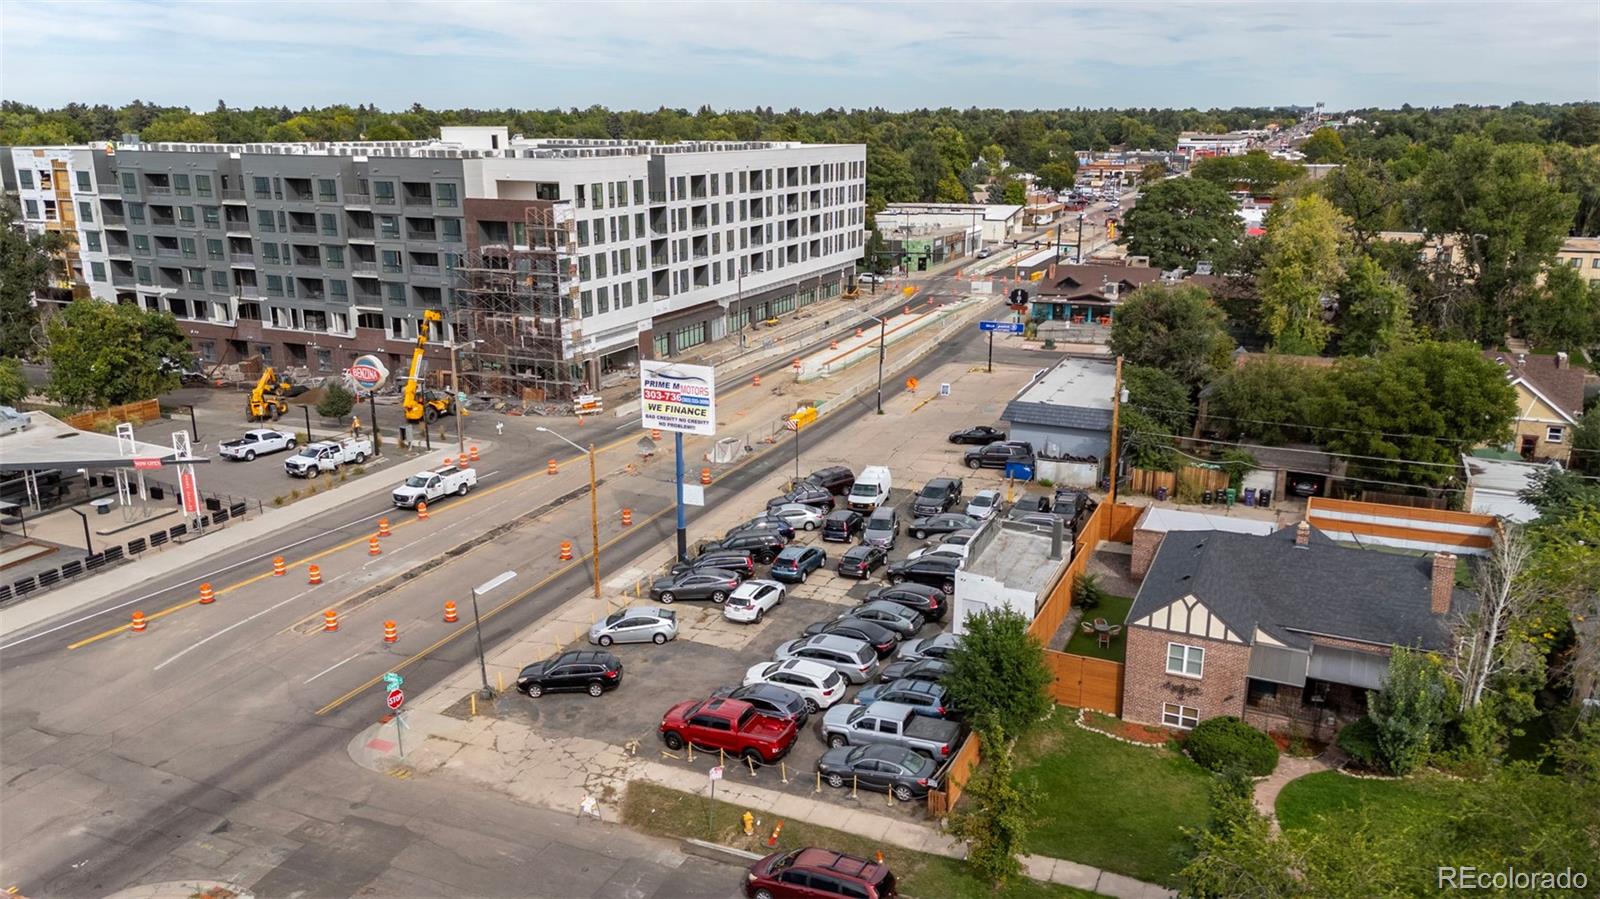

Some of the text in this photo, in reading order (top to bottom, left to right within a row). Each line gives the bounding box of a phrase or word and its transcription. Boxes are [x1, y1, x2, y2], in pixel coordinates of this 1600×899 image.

[644, 379, 671, 389] PRIME
[680, 384, 710, 396] MOTORS
[648, 403, 707, 417] WE FINANCE
[389, 694, 401, 704] STOP
